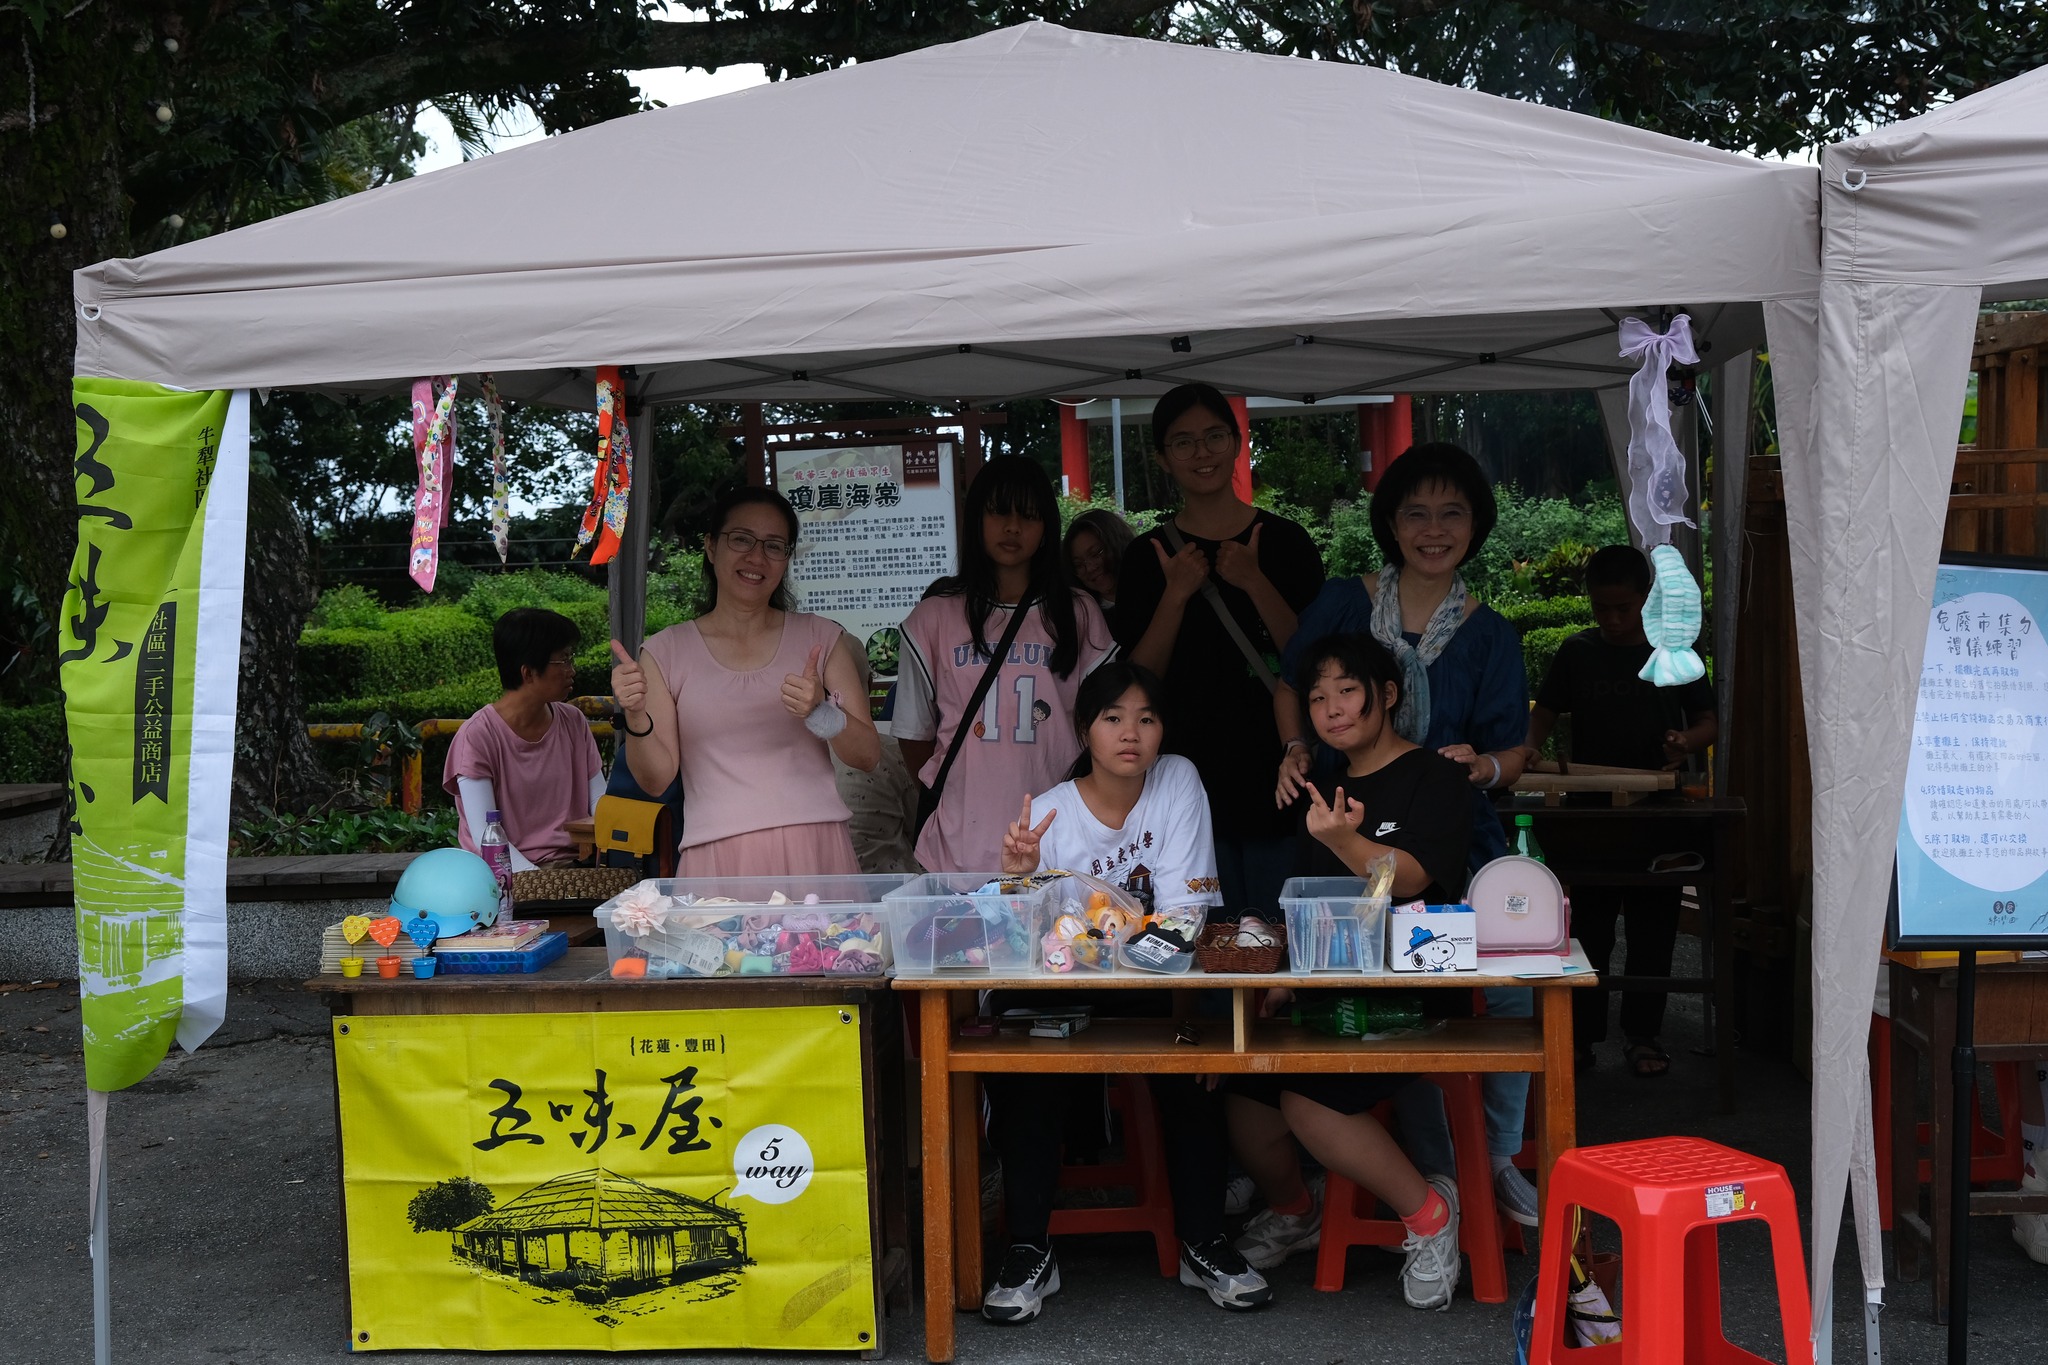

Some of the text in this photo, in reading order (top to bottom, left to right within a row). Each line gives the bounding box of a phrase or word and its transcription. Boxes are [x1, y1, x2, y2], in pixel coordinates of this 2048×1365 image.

[905, 449, 935, 457] 新城鄉
[905, 457, 936, 466] 珍貴老樹
[794, 468, 841, 481] 龍華三會
[787, 482, 901, 511] 瓊崖海棠
[1947, 636, 2021, 660] 禮儀練習
[140, 610, 168, 784] 社區二手公益商店
[980, 674, 1036, 744] 11
[1379, 821, 1397, 830] NIKE
[473, 1066, 723, 1155] 五味屋
[760, 1137, 783, 1161] 5
[745, 1165, 808, 1189] way
[1708, 1185, 1732, 1194] HOUSE
